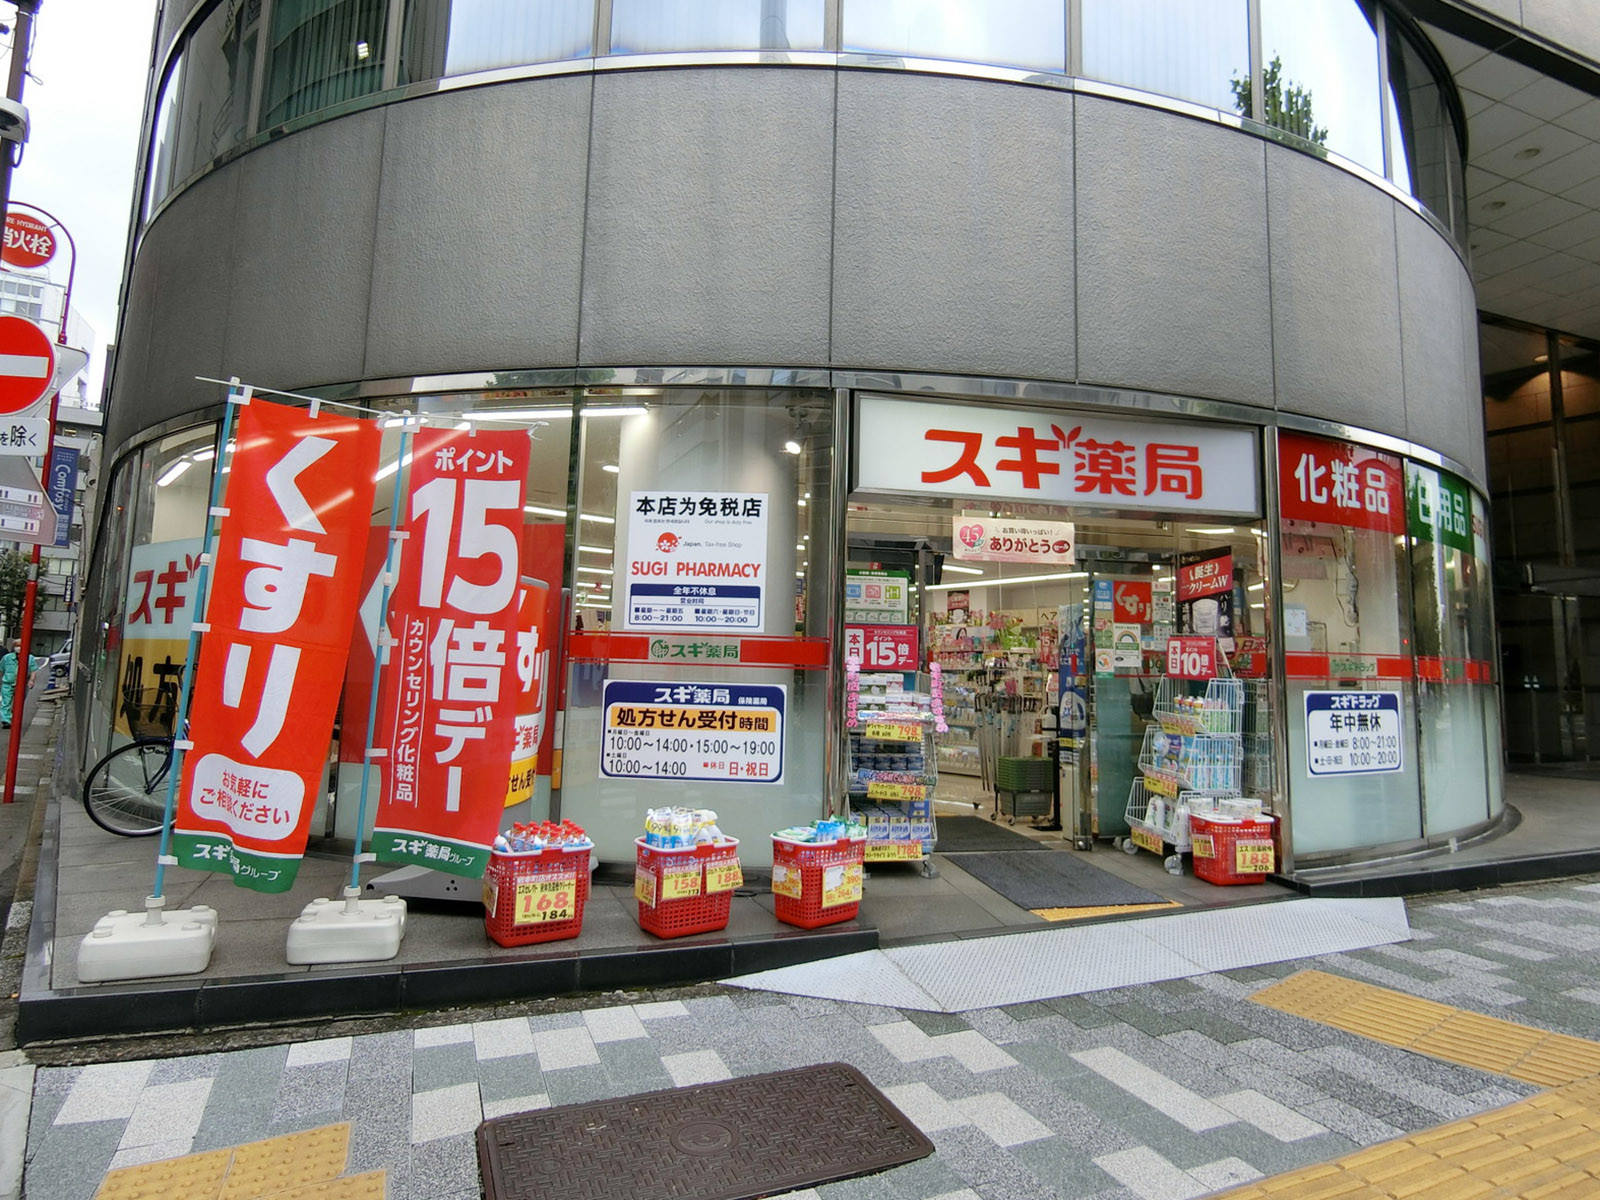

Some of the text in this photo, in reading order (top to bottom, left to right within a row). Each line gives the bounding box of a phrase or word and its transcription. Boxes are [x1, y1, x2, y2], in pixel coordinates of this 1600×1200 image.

[17, 220, 48, 232] HYDRANT
[435, 447, 513, 474] ポイント
[921, 423, 1203, 500] スギ薬局
[1294, 454, 1389, 514] 化粧品
[636, 496, 762, 517] 本店为免税店
[962, 526, 980, 542] 45
[412, 477, 521, 615] 15
[990, 536, 1051, 553] ありがとう
[631, 561, 761, 578] SUGI PHARMACY
[223, 435, 339, 759] くすり
[673, 586, 717, 596] 全年不休息
[1115, 583, 1151, 621] くすり
[1041, 611, 1057, 621] ヘア
[671, 642, 739, 658] スギ薬局
[866, 641, 896, 665] 15
[1170, 645, 1179, 668] 本日
[1180, 652, 1200, 676] 10
[654, 685, 730, 704] スギ薬局
[1331, 694, 1381, 709] スギドラッグ
[396, 619, 424, 802] カウンセリング化粧品
[897, 725, 917, 736] 798
[1330, 712, 1381, 732] 年中無休
[609, 760, 687, 775] 10:00～14:00
[222, 769, 269, 799] お気軽に
[901, 785, 921, 797] 798
[200, 787, 290, 824] ご相談ください
[392, 838, 475, 866] スギ薬局グループ
[896, 844, 918, 855] 1780
[1241, 852, 1270, 865] 188
[673, 877, 698, 890] 158
[717, 871, 739, 884] 188
[524, 891, 569, 913] 168
[542, 909, 567, 920] 184
